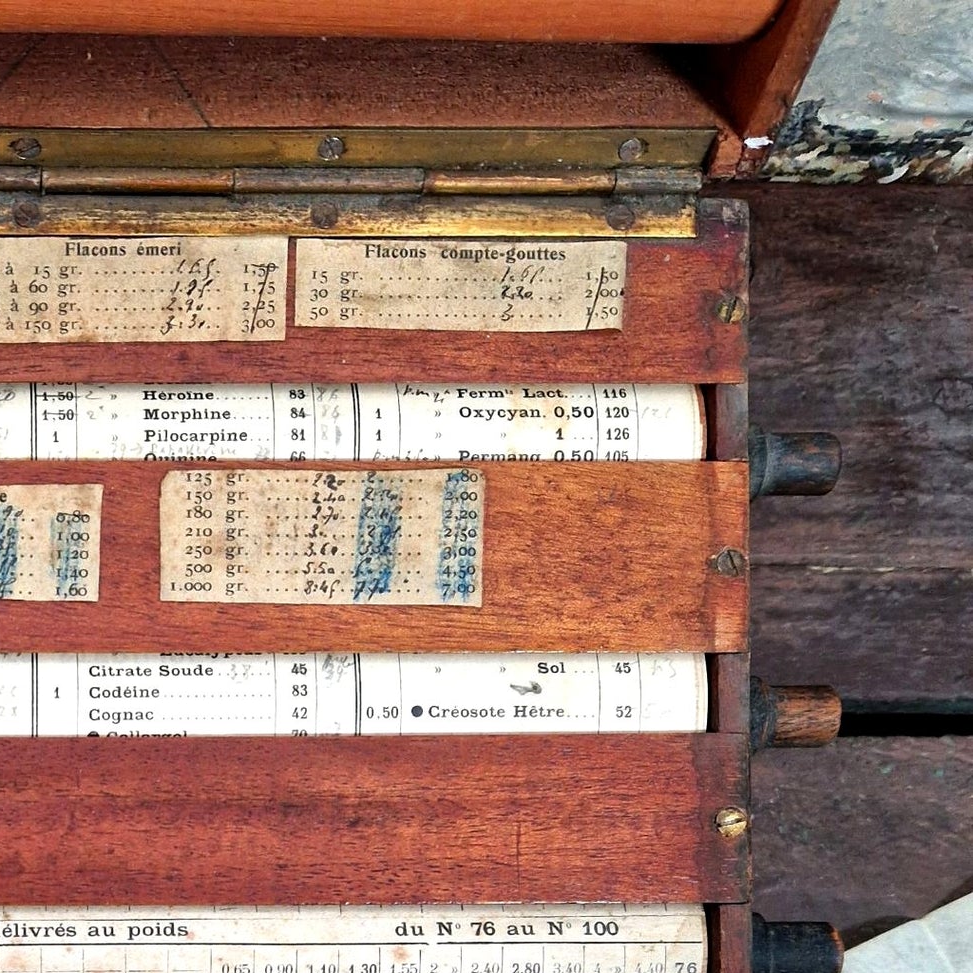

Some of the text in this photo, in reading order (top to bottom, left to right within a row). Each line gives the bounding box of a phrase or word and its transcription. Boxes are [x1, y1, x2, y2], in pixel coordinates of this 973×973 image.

[65, 242, 181, 257] Flacons émeri
[365, 244, 566, 262] Flacons compte-gouttes
[311, 271, 363, 283] 15 gr.
[11, 282, 18, 293] à
[29, 281, 47, 293] 60
[58, 284, 80, 296] gr.
[310, 288, 363, 302] 30 gr.
[310, 307, 363, 320] 50 gr.
[6, 318, 14, 330] à
[25, 320, 51, 333] 150
[59, 321, 83, 334] gr.
[289, 390, 305, 399] 83
[603, 389, 626, 399] 116
[144, 409, 231, 421] Morphine
[459, 406, 629, 420] Oxycyan. 0,50 120
[144, 429, 305, 444] Pilocarpine 81
[607, 428, 629, 440] 126
[186, 490, 249, 503] 150 gr.
[226, 581, 247, 594] gr.
[89, 664, 307, 677] Citrate Soude 45
[538, 662, 566, 674] Sol
[89, 686, 308, 698] Codéine 83
[89, 708, 308, 724] Cognac 42
[366, 706, 631, 719] 0.50 Créosote Hêtre 52
[88, 925, 115, 937] au
[128, 922, 189, 939] poids
[395, 922, 424, 936] du
[471, 922, 495, 936] 76
[507, 923, 535, 935] au
[582, 922, 618, 935] 100
